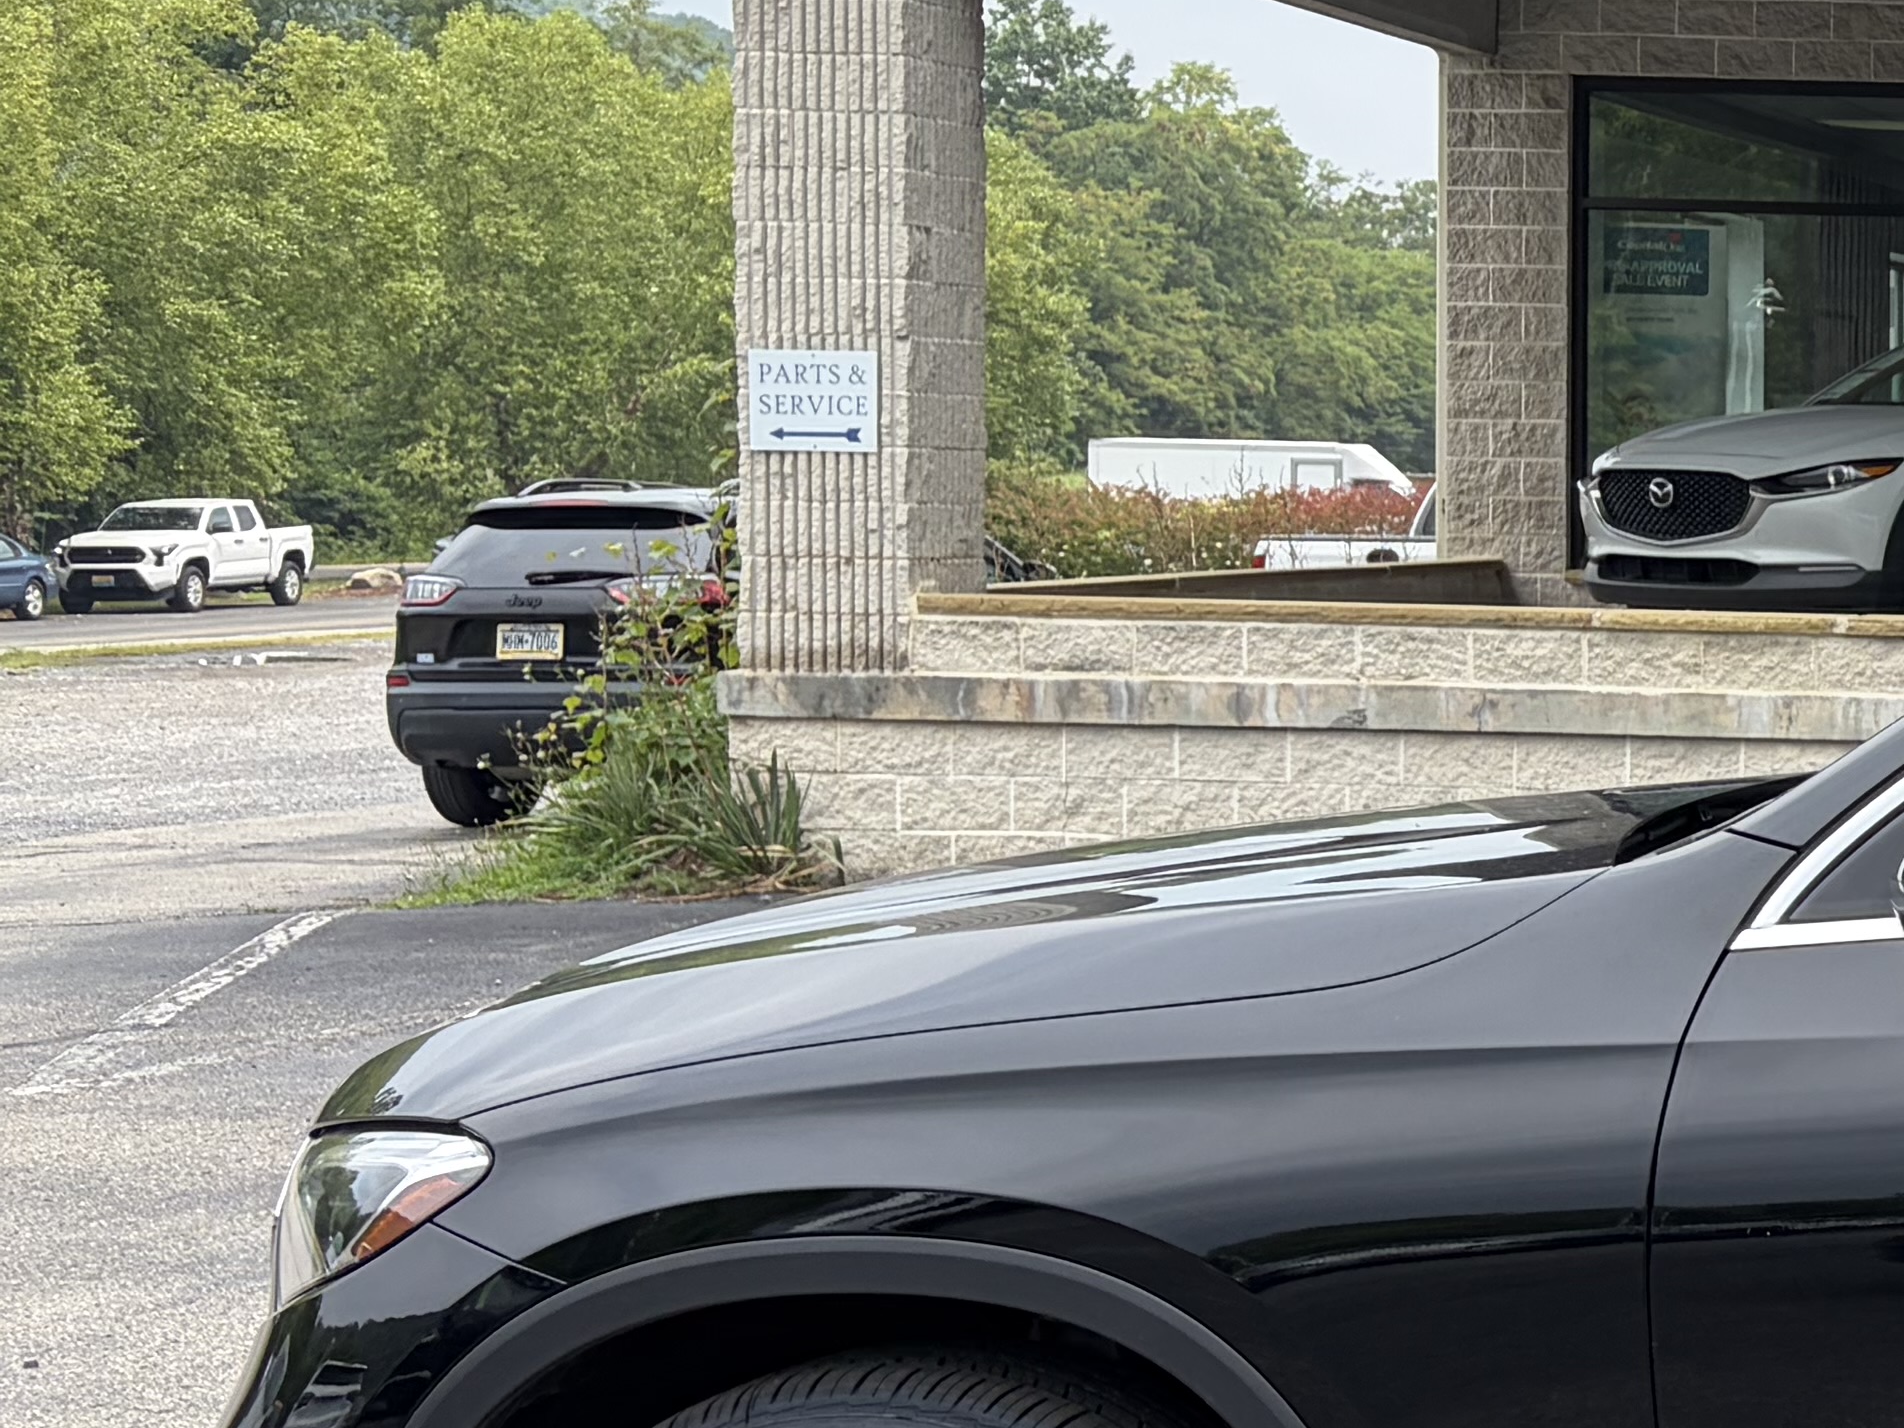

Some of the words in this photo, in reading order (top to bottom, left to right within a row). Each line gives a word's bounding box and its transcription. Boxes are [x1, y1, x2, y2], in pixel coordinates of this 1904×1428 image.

[759, 363, 840, 385] PARTS
[848, 364, 867, 385] &
[759, 394, 868, 416] SERVICE
[505, 593, 543, 609] Jeep
